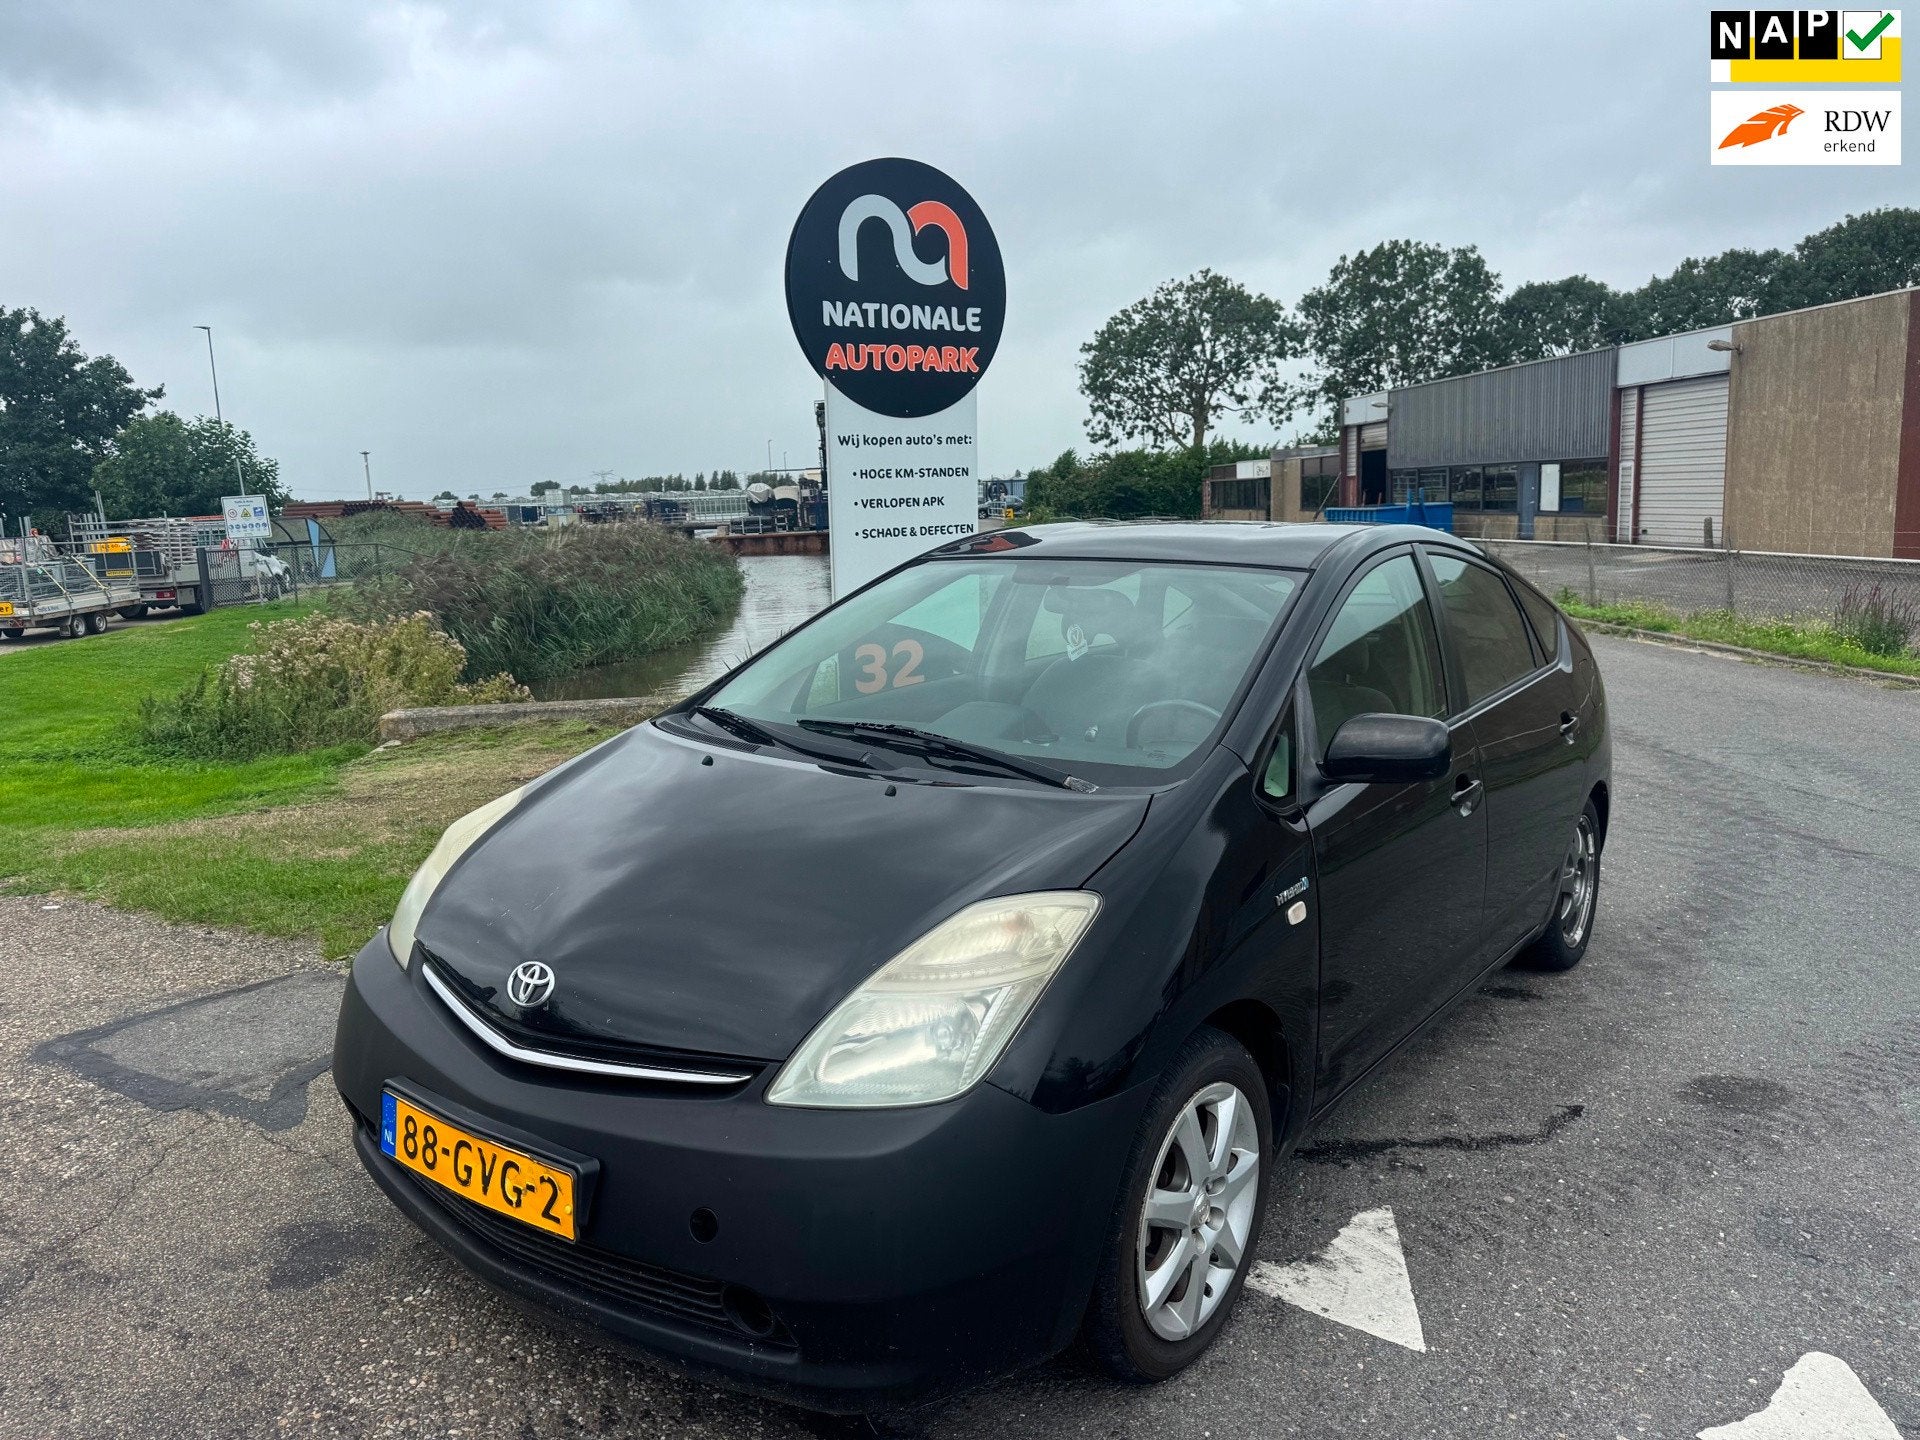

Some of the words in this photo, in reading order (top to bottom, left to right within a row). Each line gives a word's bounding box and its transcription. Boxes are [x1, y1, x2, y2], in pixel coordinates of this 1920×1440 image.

[822, 300, 982, 332] NATIONALE
[825, 342, 980, 373] AUTOPARK
[838, 434, 860, 449] Wij
[863, 434, 903, 448] kopen
[905, 433, 943, 446] auto's
[945, 434, 973, 445] met:
[859, 468, 893, 479] HOGE
[895, 467, 969, 479] KM-STANDEN
[860, 497, 920, 509] VERLOPEN
[922, 496, 945, 507] APK
[862, 527, 908, 539] SCHADE
[909, 527, 918, 537] &
[919, 523, 974, 537] DEFECTEN
[854, 638, 926, 695] 32
[384, 1128, 395, 1146] NL
[402, 1114, 562, 1226] 88-GVG-2
